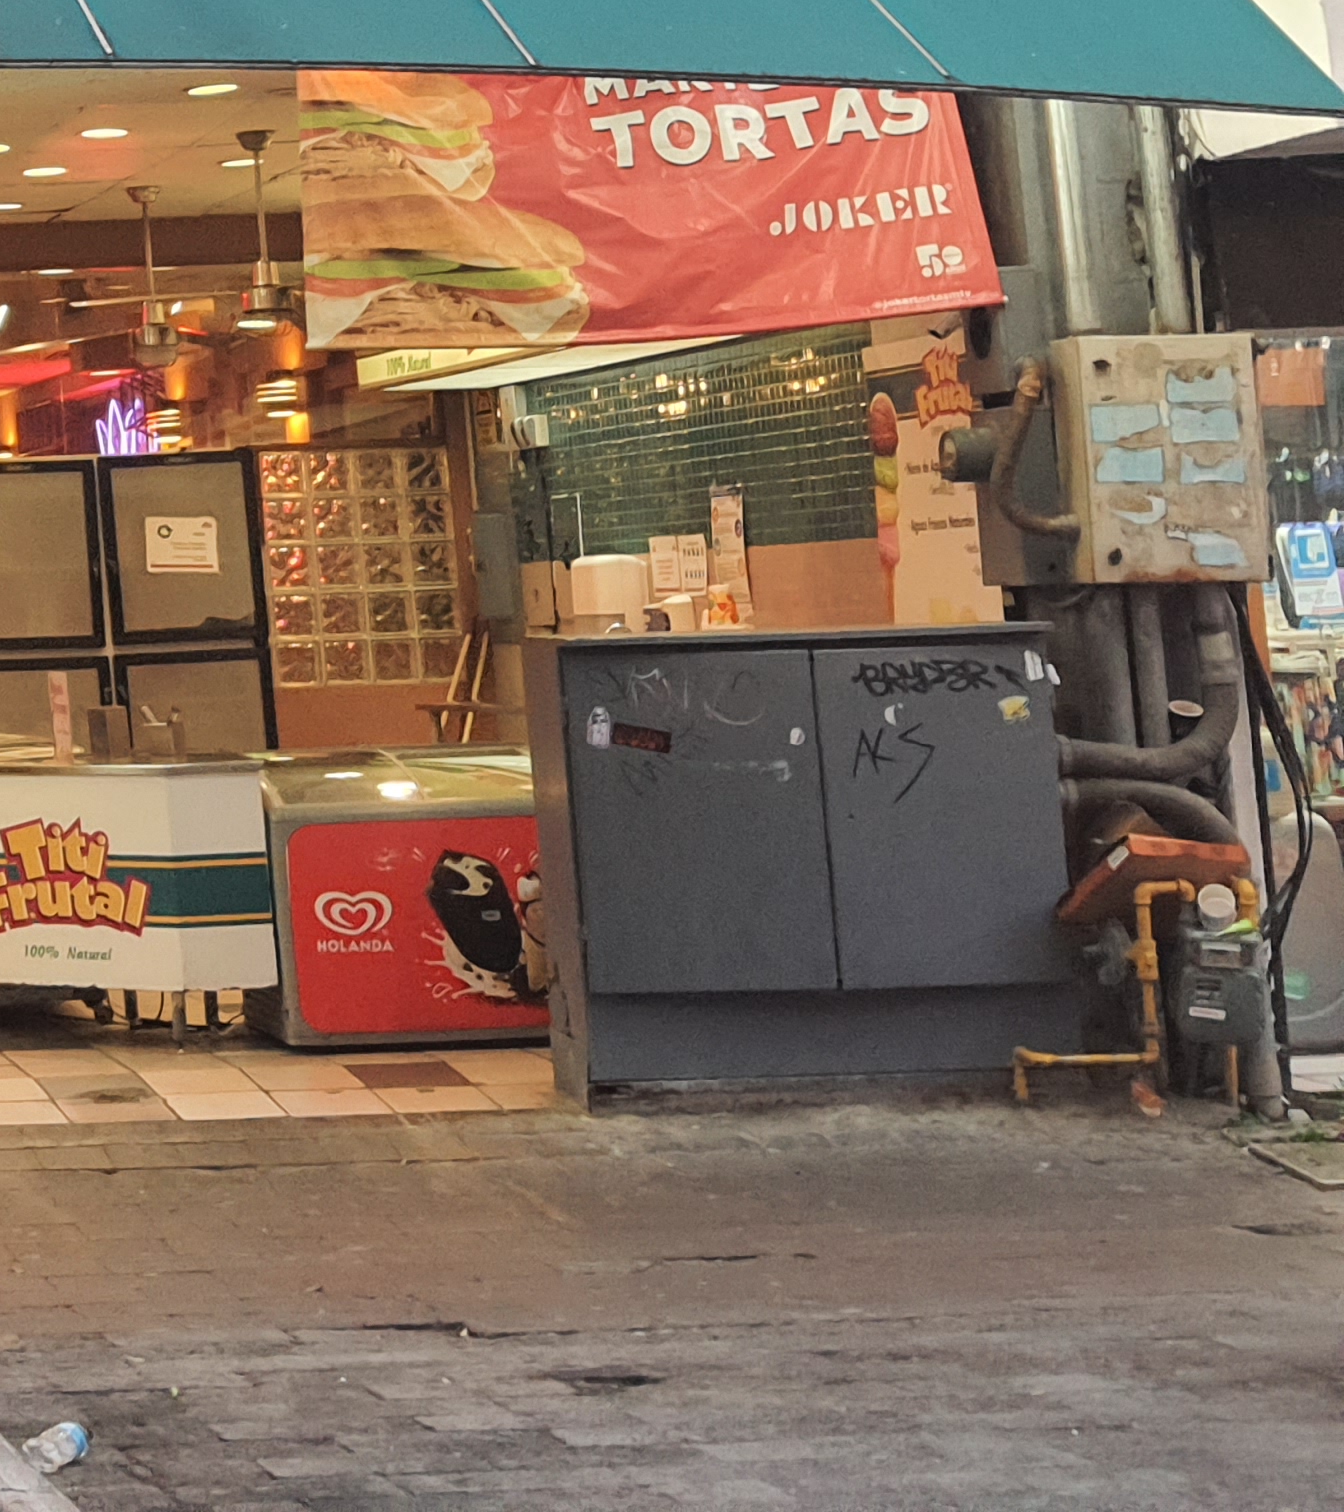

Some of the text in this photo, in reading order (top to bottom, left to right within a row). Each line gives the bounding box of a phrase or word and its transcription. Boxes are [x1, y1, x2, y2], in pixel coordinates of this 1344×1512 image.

[590, 88, 929, 168] TORTAS
[769, 184, 952, 236] JOKER
[2, 819, 107, 881] Titi
[25, 944, 113, 962] 100% Natural
[316, 939, 395, 953] HOLANDA
